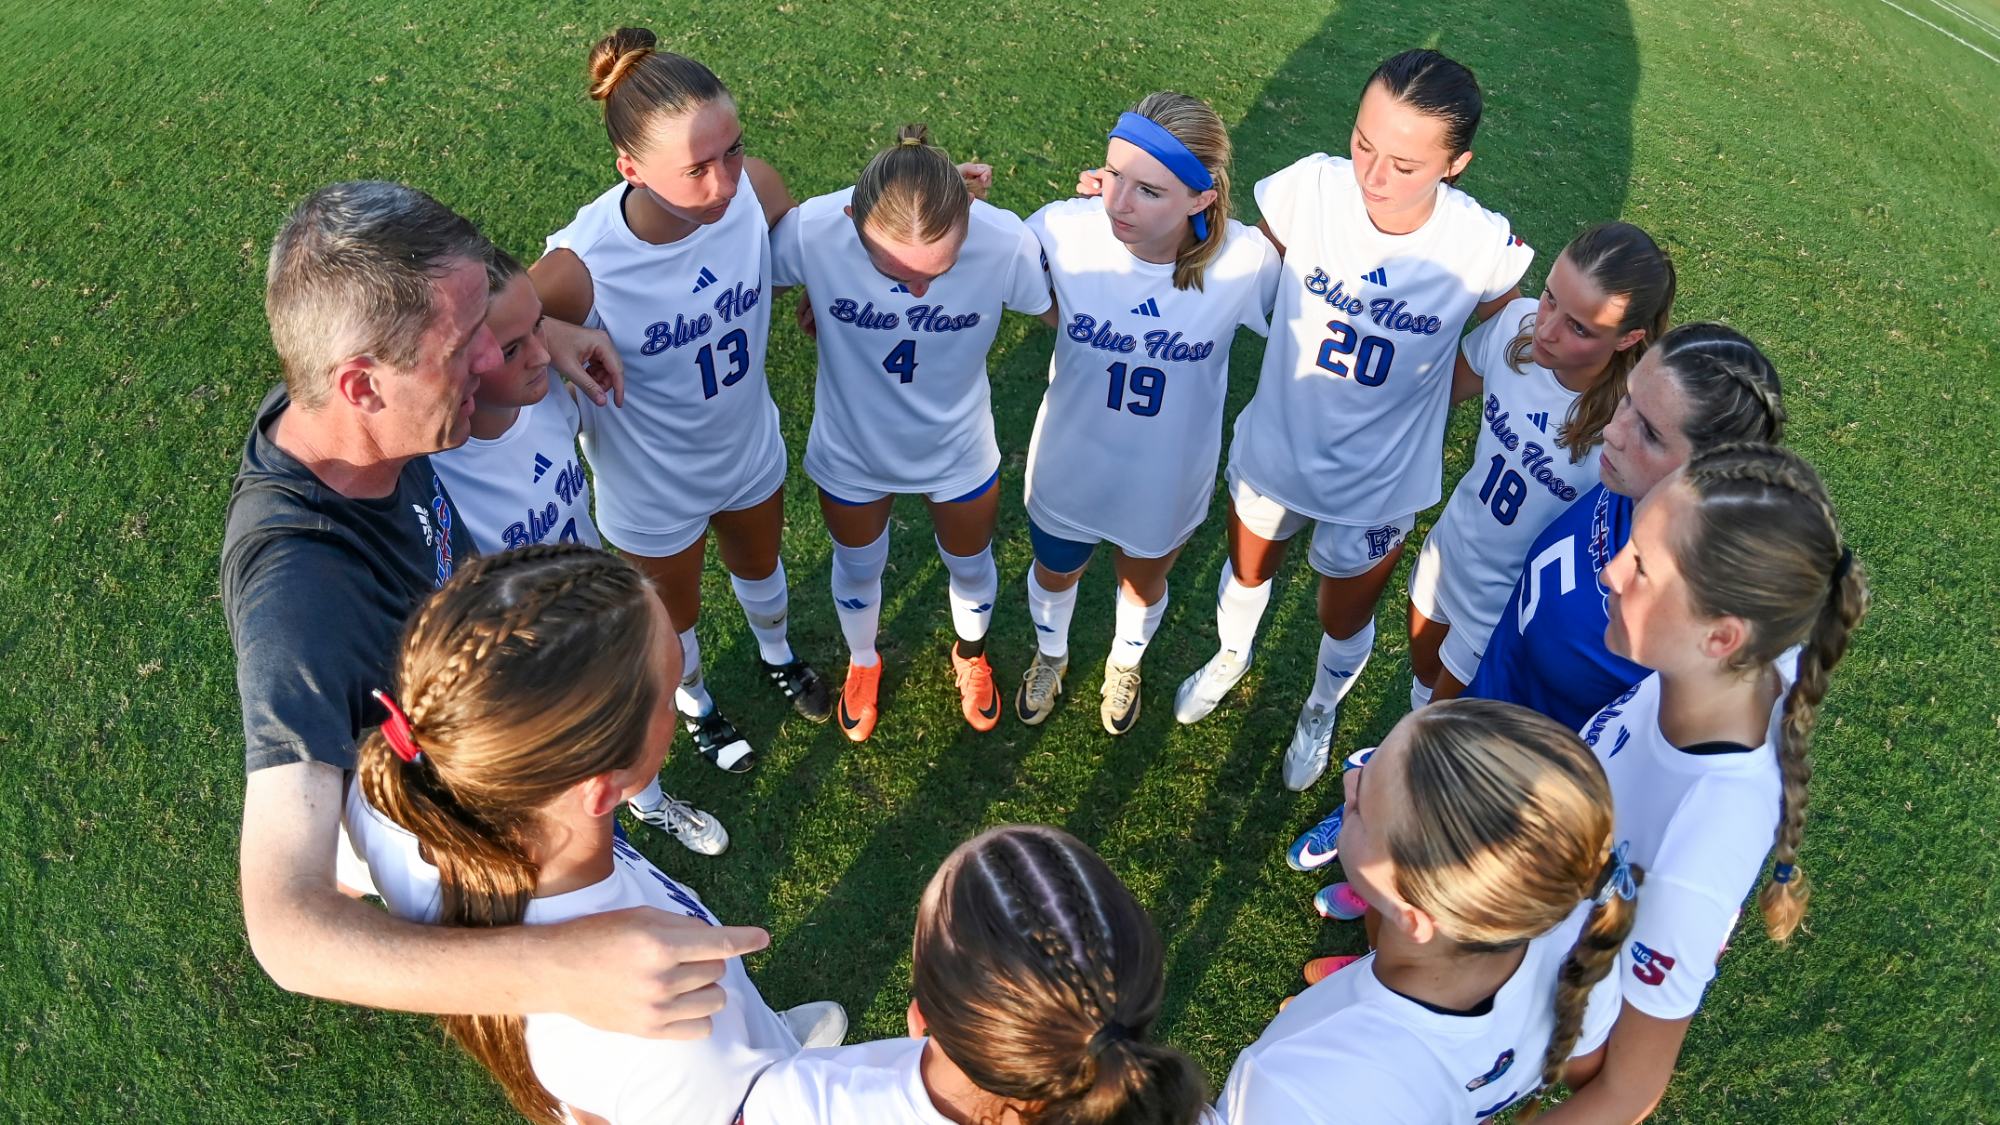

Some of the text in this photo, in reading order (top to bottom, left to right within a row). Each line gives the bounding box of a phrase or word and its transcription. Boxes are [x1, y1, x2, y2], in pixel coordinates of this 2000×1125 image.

[829, 298, 980, 333] Blue Hose
[1304, 266, 1442, 336] Blue Hose
[641, 313, 712, 357] Blue
[694, 328, 750, 400] 13
[882, 339, 919, 384] 4
[1067, 313, 1215, 362] Blue Hose
[1315, 320, 1395, 387] 20
[1106, 361, 1167, 417] 19
[1484, 393, 1578, 503] Blue Hose
[1479, 453, 1527, 527] 18
[1517, 534, 1576, 637] 5
